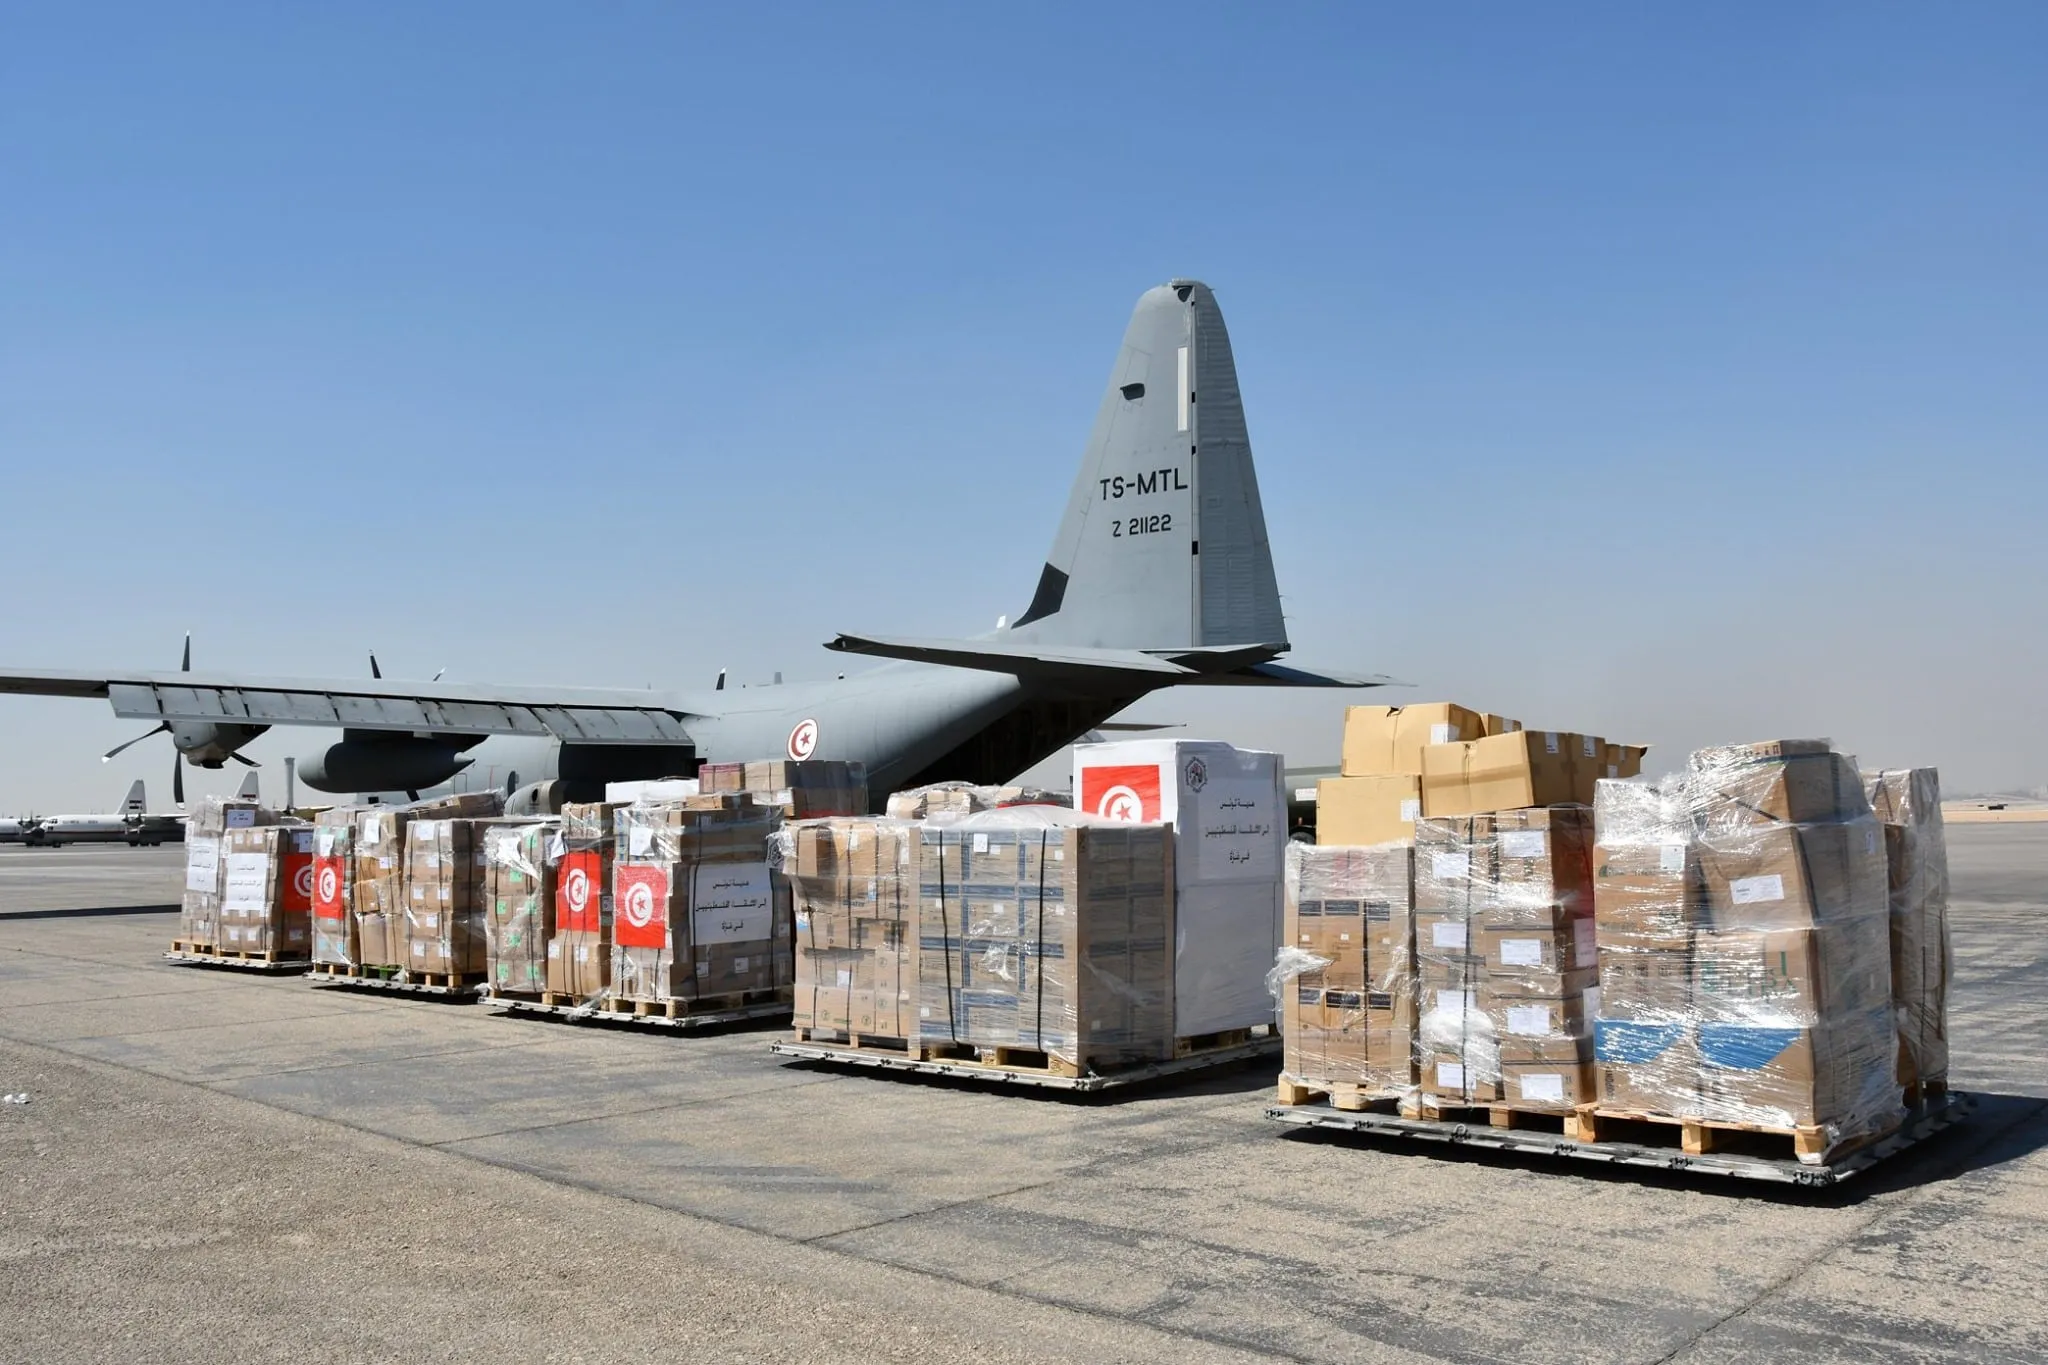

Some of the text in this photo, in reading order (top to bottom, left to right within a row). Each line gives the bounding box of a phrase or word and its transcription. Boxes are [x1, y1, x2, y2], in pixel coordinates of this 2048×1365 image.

[1100, 467, 1188, 500] TS-MTL
[1112, 514, 1172, 537] Z 21122
